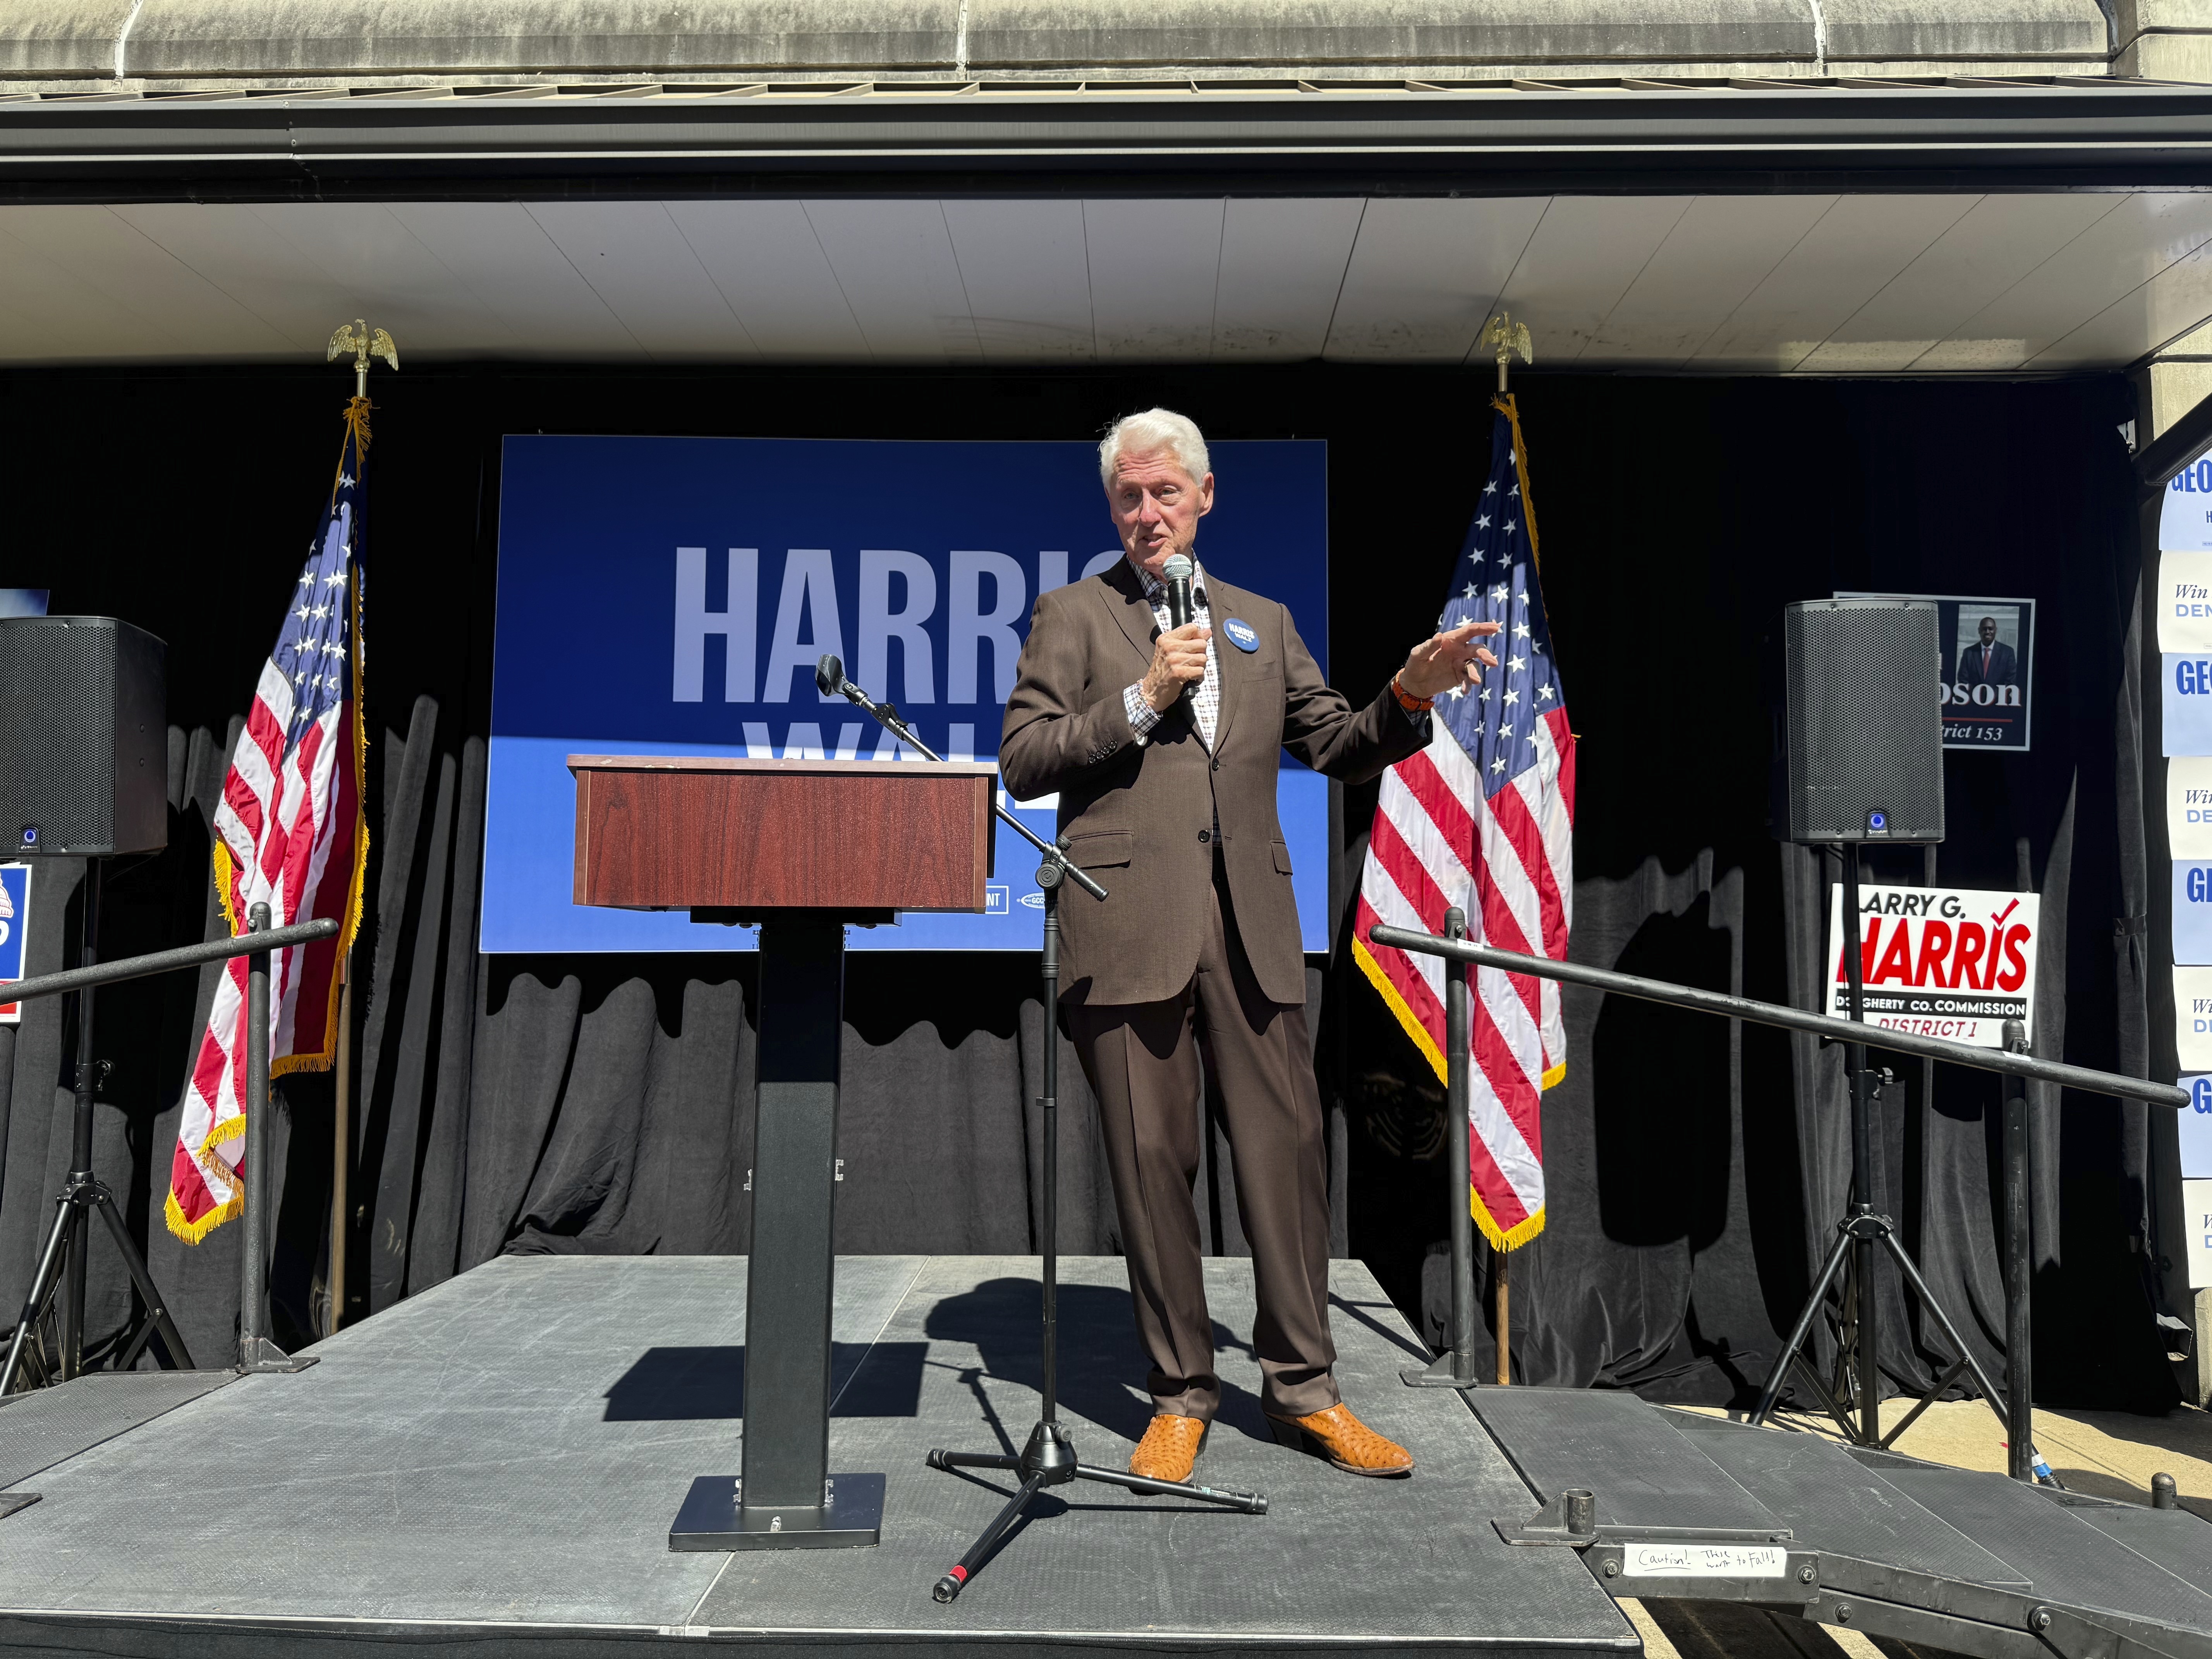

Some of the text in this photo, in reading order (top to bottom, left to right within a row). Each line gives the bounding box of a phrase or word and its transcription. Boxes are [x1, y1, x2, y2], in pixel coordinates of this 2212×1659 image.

[2176, 585, 2207, 598] Win
[673, 547, 1126, 704] HARR
[1229, 623, 1255, 639] HARRIS
[1235, 633, 1252, 642] WALZ
[2176, 661, 2212, 695] GE
[1975, 728, 2002, 741] 153
[1859, 892, 1966, 919] ARRY G.
[1836, 996, 2026, 1015] DGHERTY CO. COMMISSION
[1879, 1018, 1966, 1037] DISTRICT
[1639, 1549, 1691, 1565] Caution!
[1737, 1555, 1746, 1565] to
[1748, 1549, 1775, 1568] Fall!
